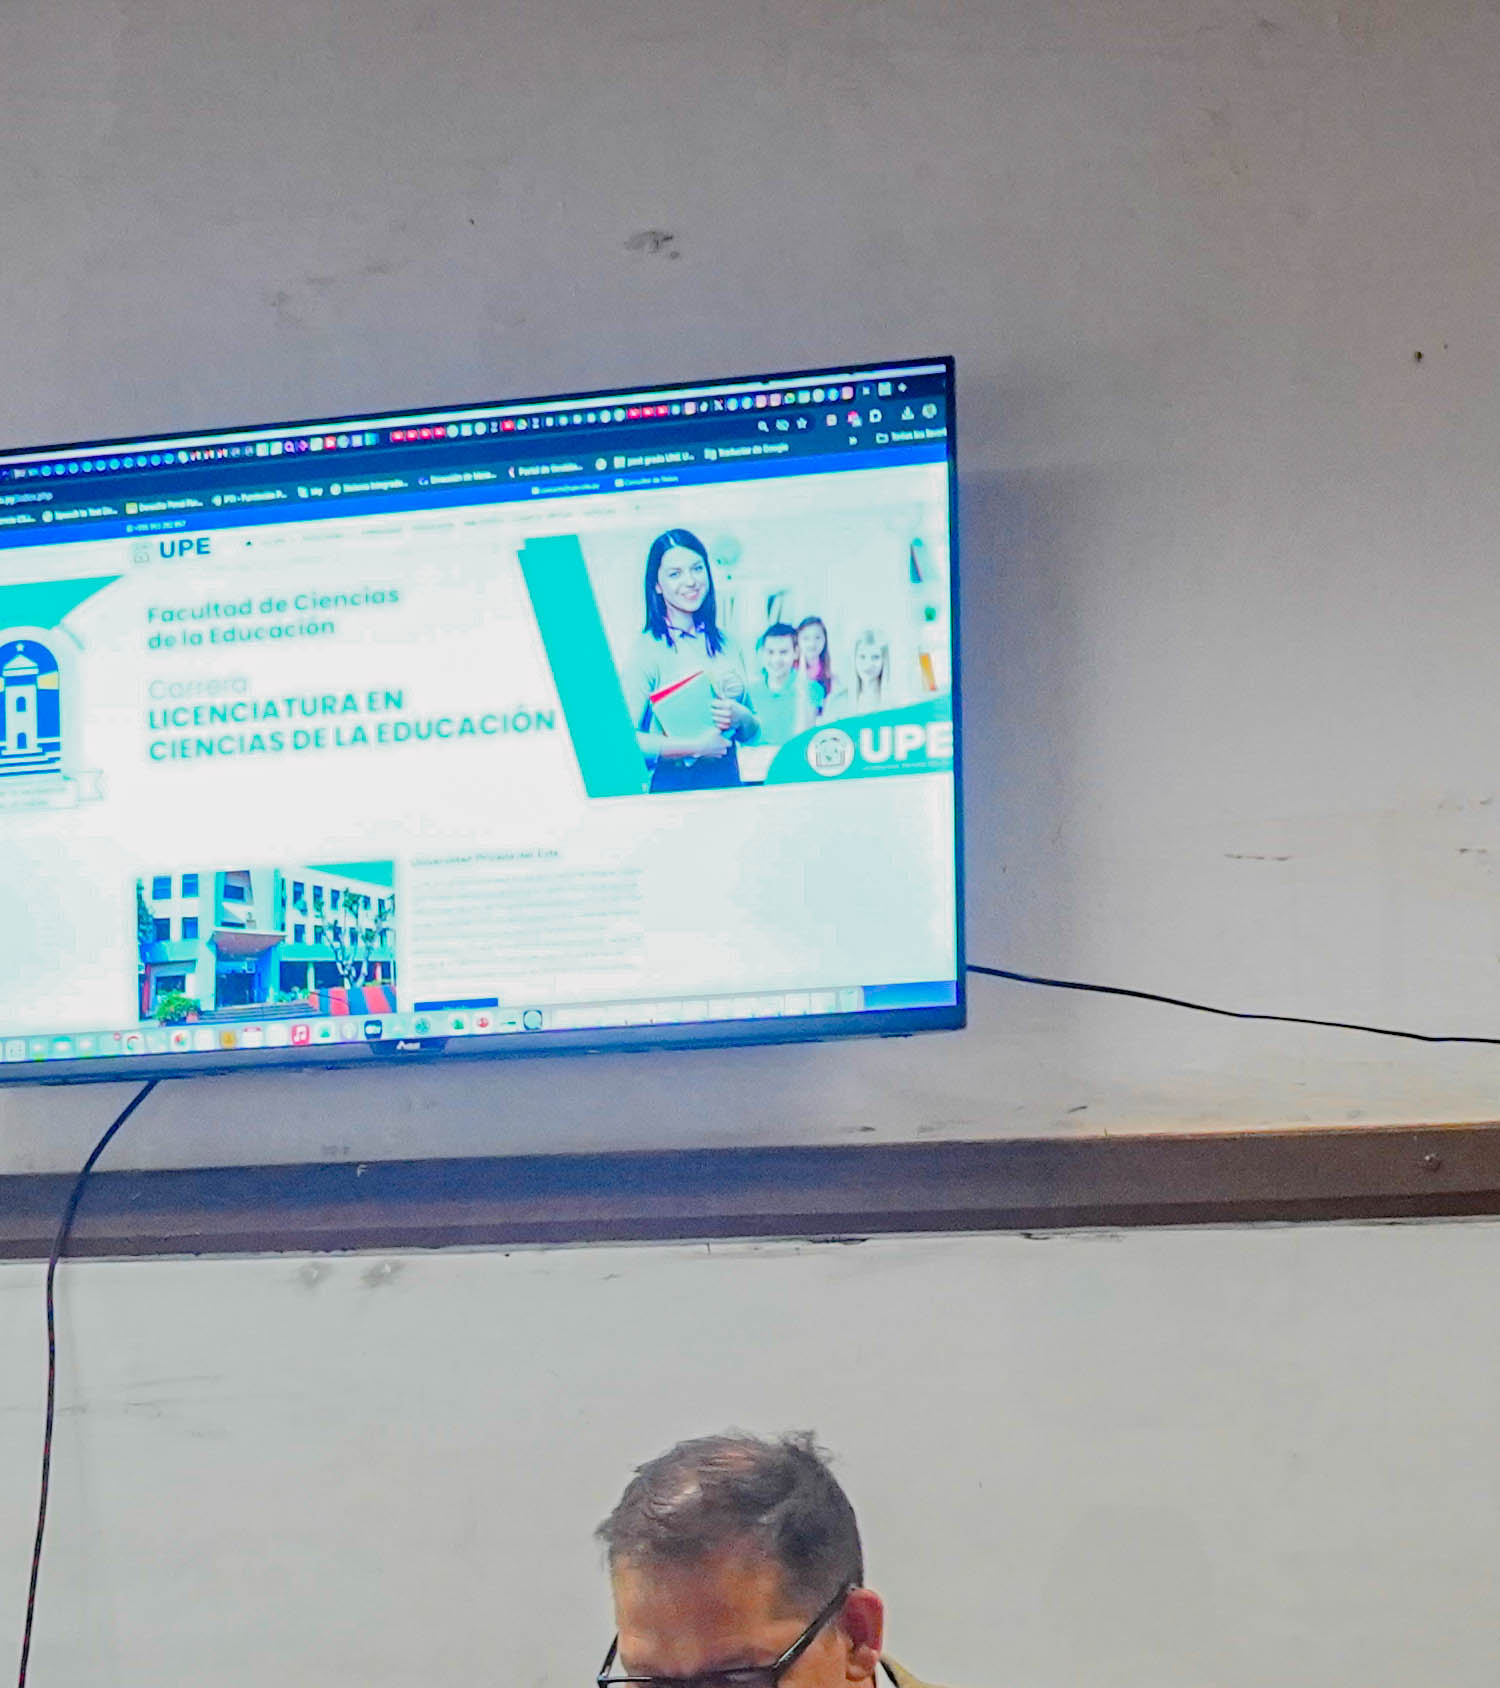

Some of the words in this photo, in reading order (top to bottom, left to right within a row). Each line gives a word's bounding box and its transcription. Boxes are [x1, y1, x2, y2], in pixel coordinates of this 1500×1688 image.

[159, 537, 211, 559] UPE
[148, 599, 252, 624] Facultad
[259, 596, 288, 614] de
[294, 587, 400, 611] Ciencias
[148, 633, 176, 650] de
[183, 630, 203, 646] la
[149, 692, 359, 730] LICENCIATURA
[367, 688, 404, 713] EN
[150, 731, 285, 761] CIENCIAS
[293, 728, 327, 751] DE
[335, 725, 368, 747] LA
[377, 705, 556, 744] EDUCACIÓN
[859, 721, 954, 764] UPE
